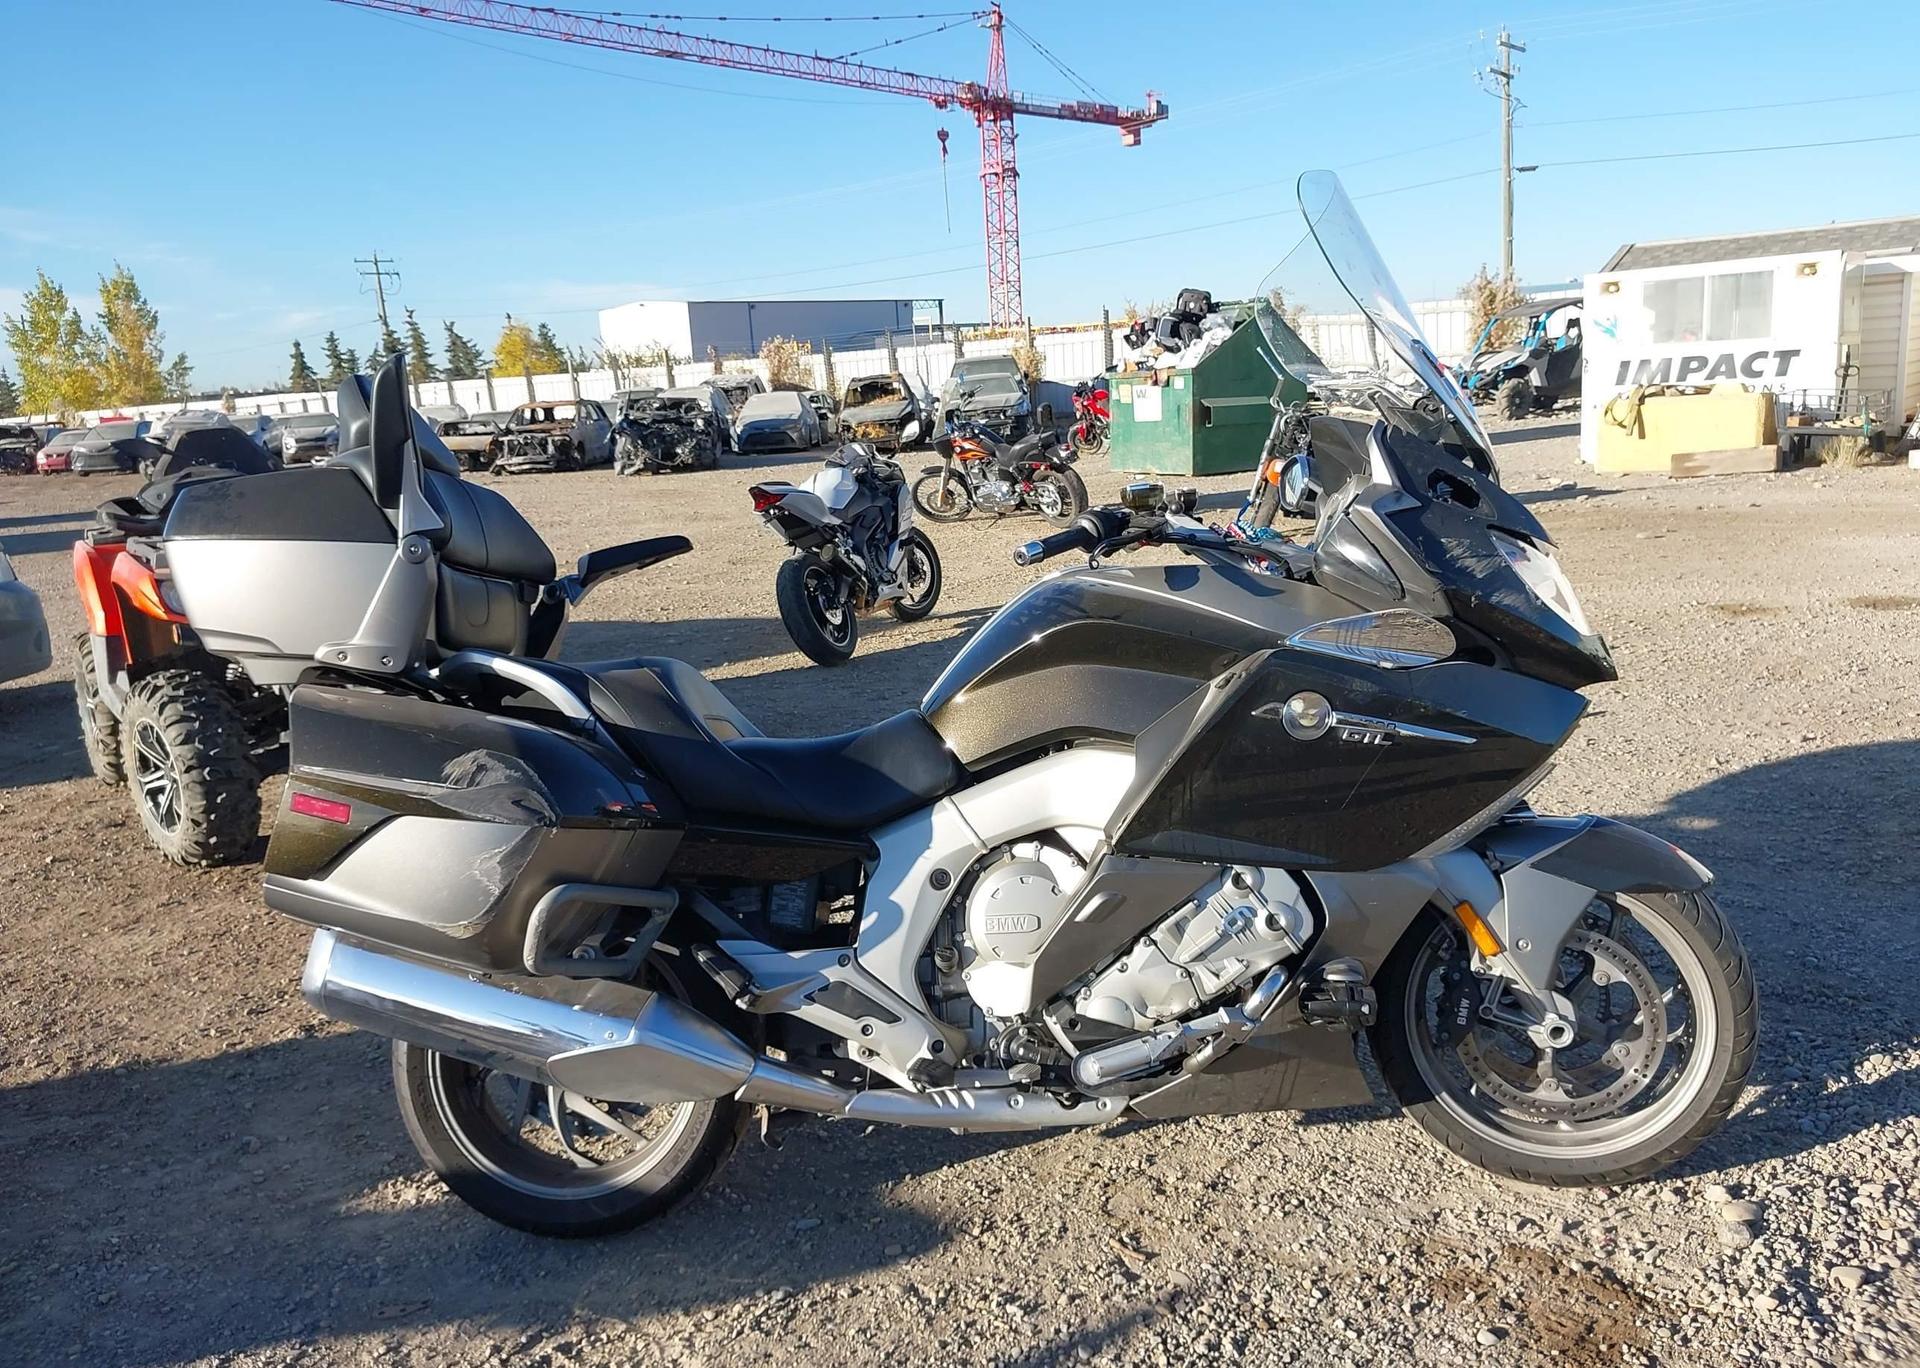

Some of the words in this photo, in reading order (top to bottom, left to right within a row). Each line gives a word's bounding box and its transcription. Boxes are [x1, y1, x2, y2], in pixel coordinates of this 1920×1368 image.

[1615, 349, 1801, 386] IMPACT
[1747, 383, 1786, 393] ONS
[1342, 728, 1393, 746] GTL
[986, 916, 1028, 932] BMW
[1456, 998, 1470, 1025] BMW
